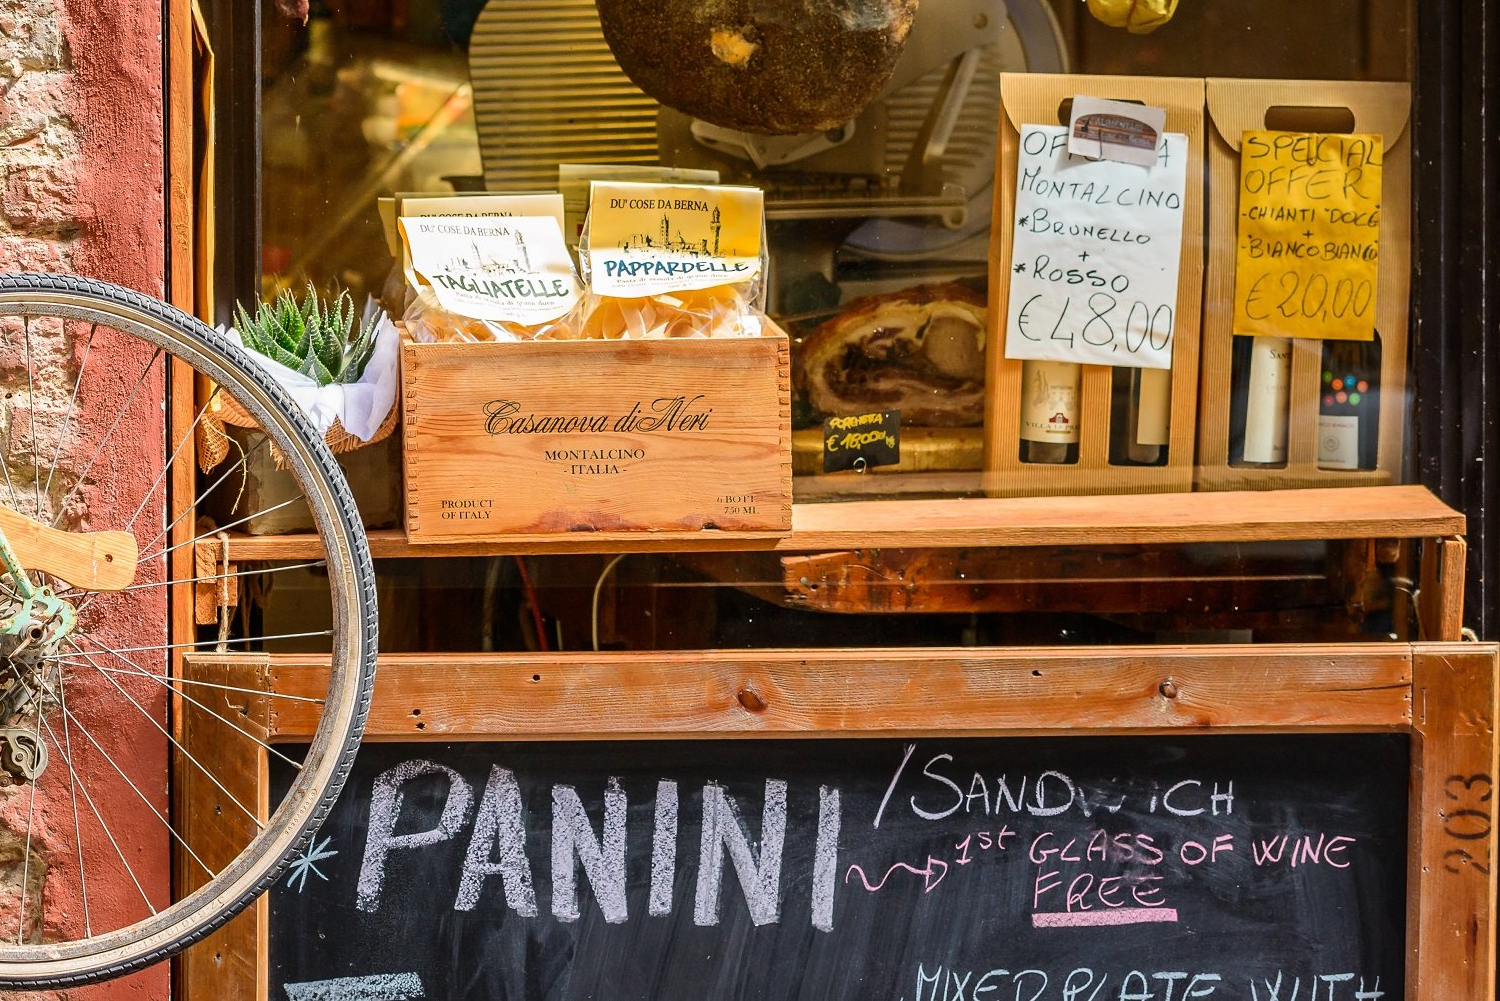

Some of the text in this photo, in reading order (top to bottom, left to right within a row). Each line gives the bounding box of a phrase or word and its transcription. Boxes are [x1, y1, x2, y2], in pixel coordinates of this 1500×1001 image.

[1248, 135, 1382, 167] SPECIAL
[1021, 166, 1180, 210] MONTALCINO
[1244, 166, 1370, 199] OFFER
[630, 199, 655, 209] COSE
[657, 199, 672, 210] DA
[673, 200, 709, 212] BERNA
[437, 225, 463, 235] COSE
[463, 226, 477, 237] DA
[477, 227, 510, 238] BERNA
[603, 259, 749, 278] PAPPARDELLE
[432, 274, 569, 299] TAGLIATELLE
[482, 395, 713, 438] Casanova di Neri
[1025, 421, 1051, 429] VILLA
[544, 448, 646, 462] MONTALCINO
[441, 499, 495, 509] PRODUCT
[441, 510, 492, 520] OF ITALY
[355, 758, 842, 933] PANINI
[955, 825, 1357, 869] 1st GLASS OF WINE
[1033, 868, 1166, 912] FREE
[916, 963, 1049, 1001] MIXED
